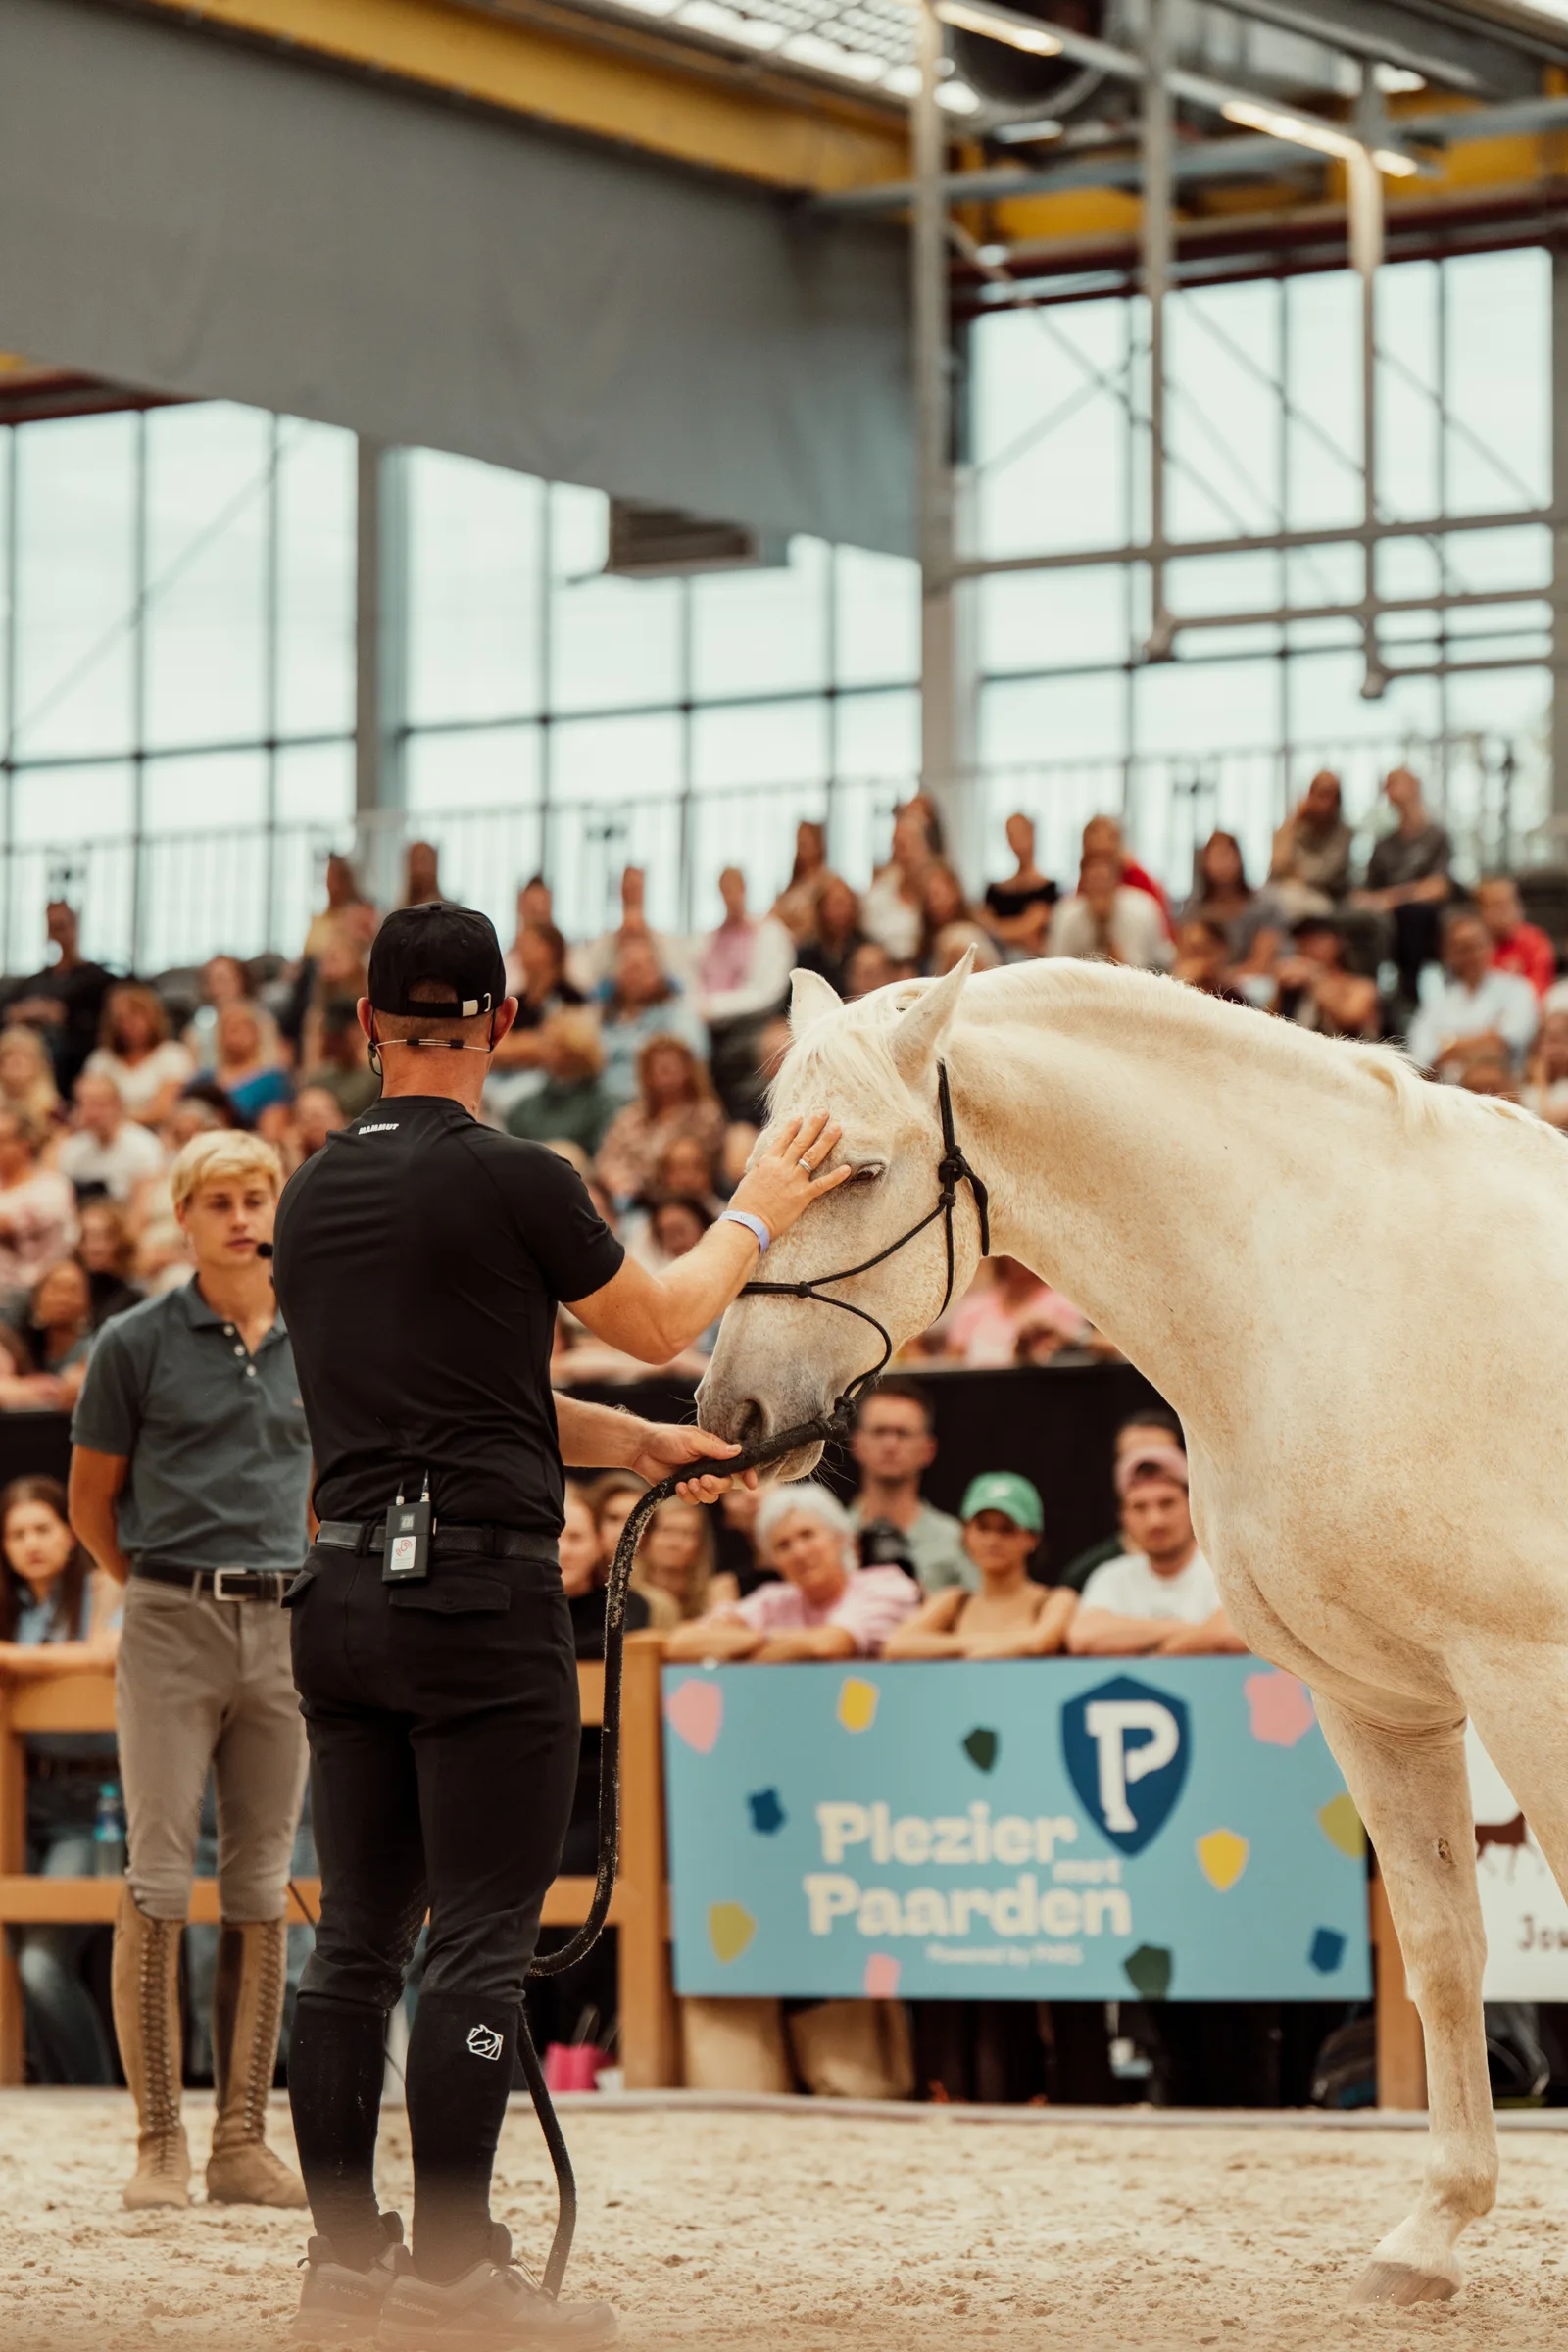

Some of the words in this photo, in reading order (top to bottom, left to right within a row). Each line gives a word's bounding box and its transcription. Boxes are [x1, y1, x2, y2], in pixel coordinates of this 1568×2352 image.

[358, 1123, 400, 1135] MAMMUT
[815, 1801, 1078, 1864] Plezier
[804, 1873, 1133, 1936] Paarden
[389, 2297, 440, 2317] SALOMON
